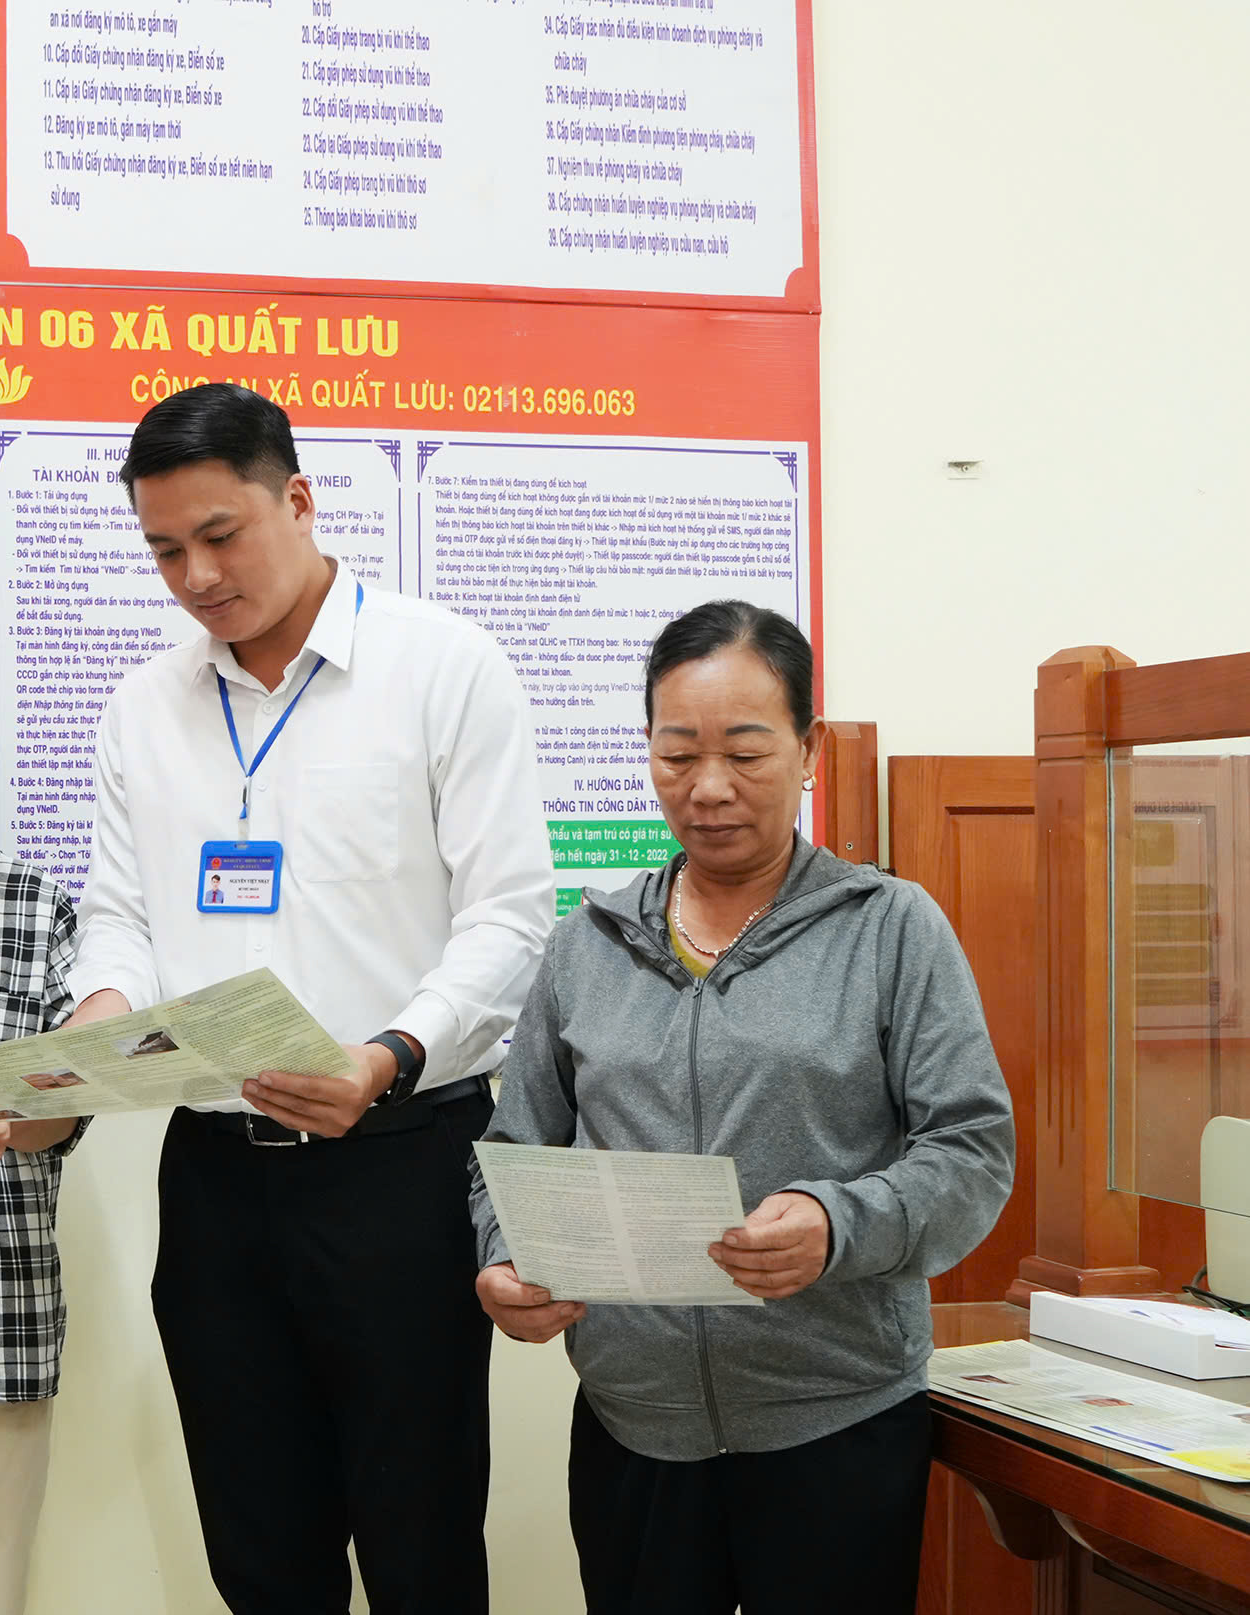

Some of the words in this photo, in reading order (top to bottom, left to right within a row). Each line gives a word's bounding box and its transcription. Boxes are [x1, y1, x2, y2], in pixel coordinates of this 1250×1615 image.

[545, 85, 555, 103] 35.
[556, 85, 568, 104] Phê
[569, 86, 588, 110] duyệt
[589, 87, 613, 111] phương
[614, 88, 622, 107] án
[623, 89, 639, 108] chữa
[640, 90, 655, 114] cháy
[656, 90, 668, 110] của
[669, 94, 677, 110] cơ
[678, 91, 686, 111] sở
[40, 309, 94, 348] 06
[110, 304, 171, 350] XÃ
[187, 302, 301, 356] QUẤT
[317, 314, 398, 356] LƯU
[268, 372, 303, 406] XÃ
[311, 368, 385, 408] QUẤT
[395, 379, 453, 410] LƯU:
[463, 384, 635, 415] 02113.696.063
[86, 448, 100, 460] III.
[32, 466, 51, 481] TÀI
[56, 466, 98, 482] KHOẢN
[317, 475, 351, 487] VNEID
[8, 490, 13, 498] 1.
[15, 489, 33, 499] Bước
[35, 490, 41, 499] 1:
[43, 489, 54, 499] Tải
[55, 490, 68, 502] ứng
[70, 491, 87, 502] dụng
[574, 779, 584, 790] IV.
[587, 775, 621, 791] HƯỚNG
[624, 773, 643, 790] DẪN
[542, 797, 575, 812] THÔNG
[578, 800, 593, 811] TIN
[596, 797, 624, 812] CÔNG
[626, 796, 646, 811] DÂN
[571, 828, 582, 840] và
[584, 828, 602, 842] tạm
[603, 827, 617, 840] trú
[619, 828, 630, 840] có
[632, 828, 646, 843] giá
[648, 828, 658, 842] trị
[567, 847, 582, 862] hết
[584, 848, 608, 864] ngày
[609, 849, 619, 861] 31
[628, 848, 638, 861] 12
[646, 849, 668, 862] 2022
